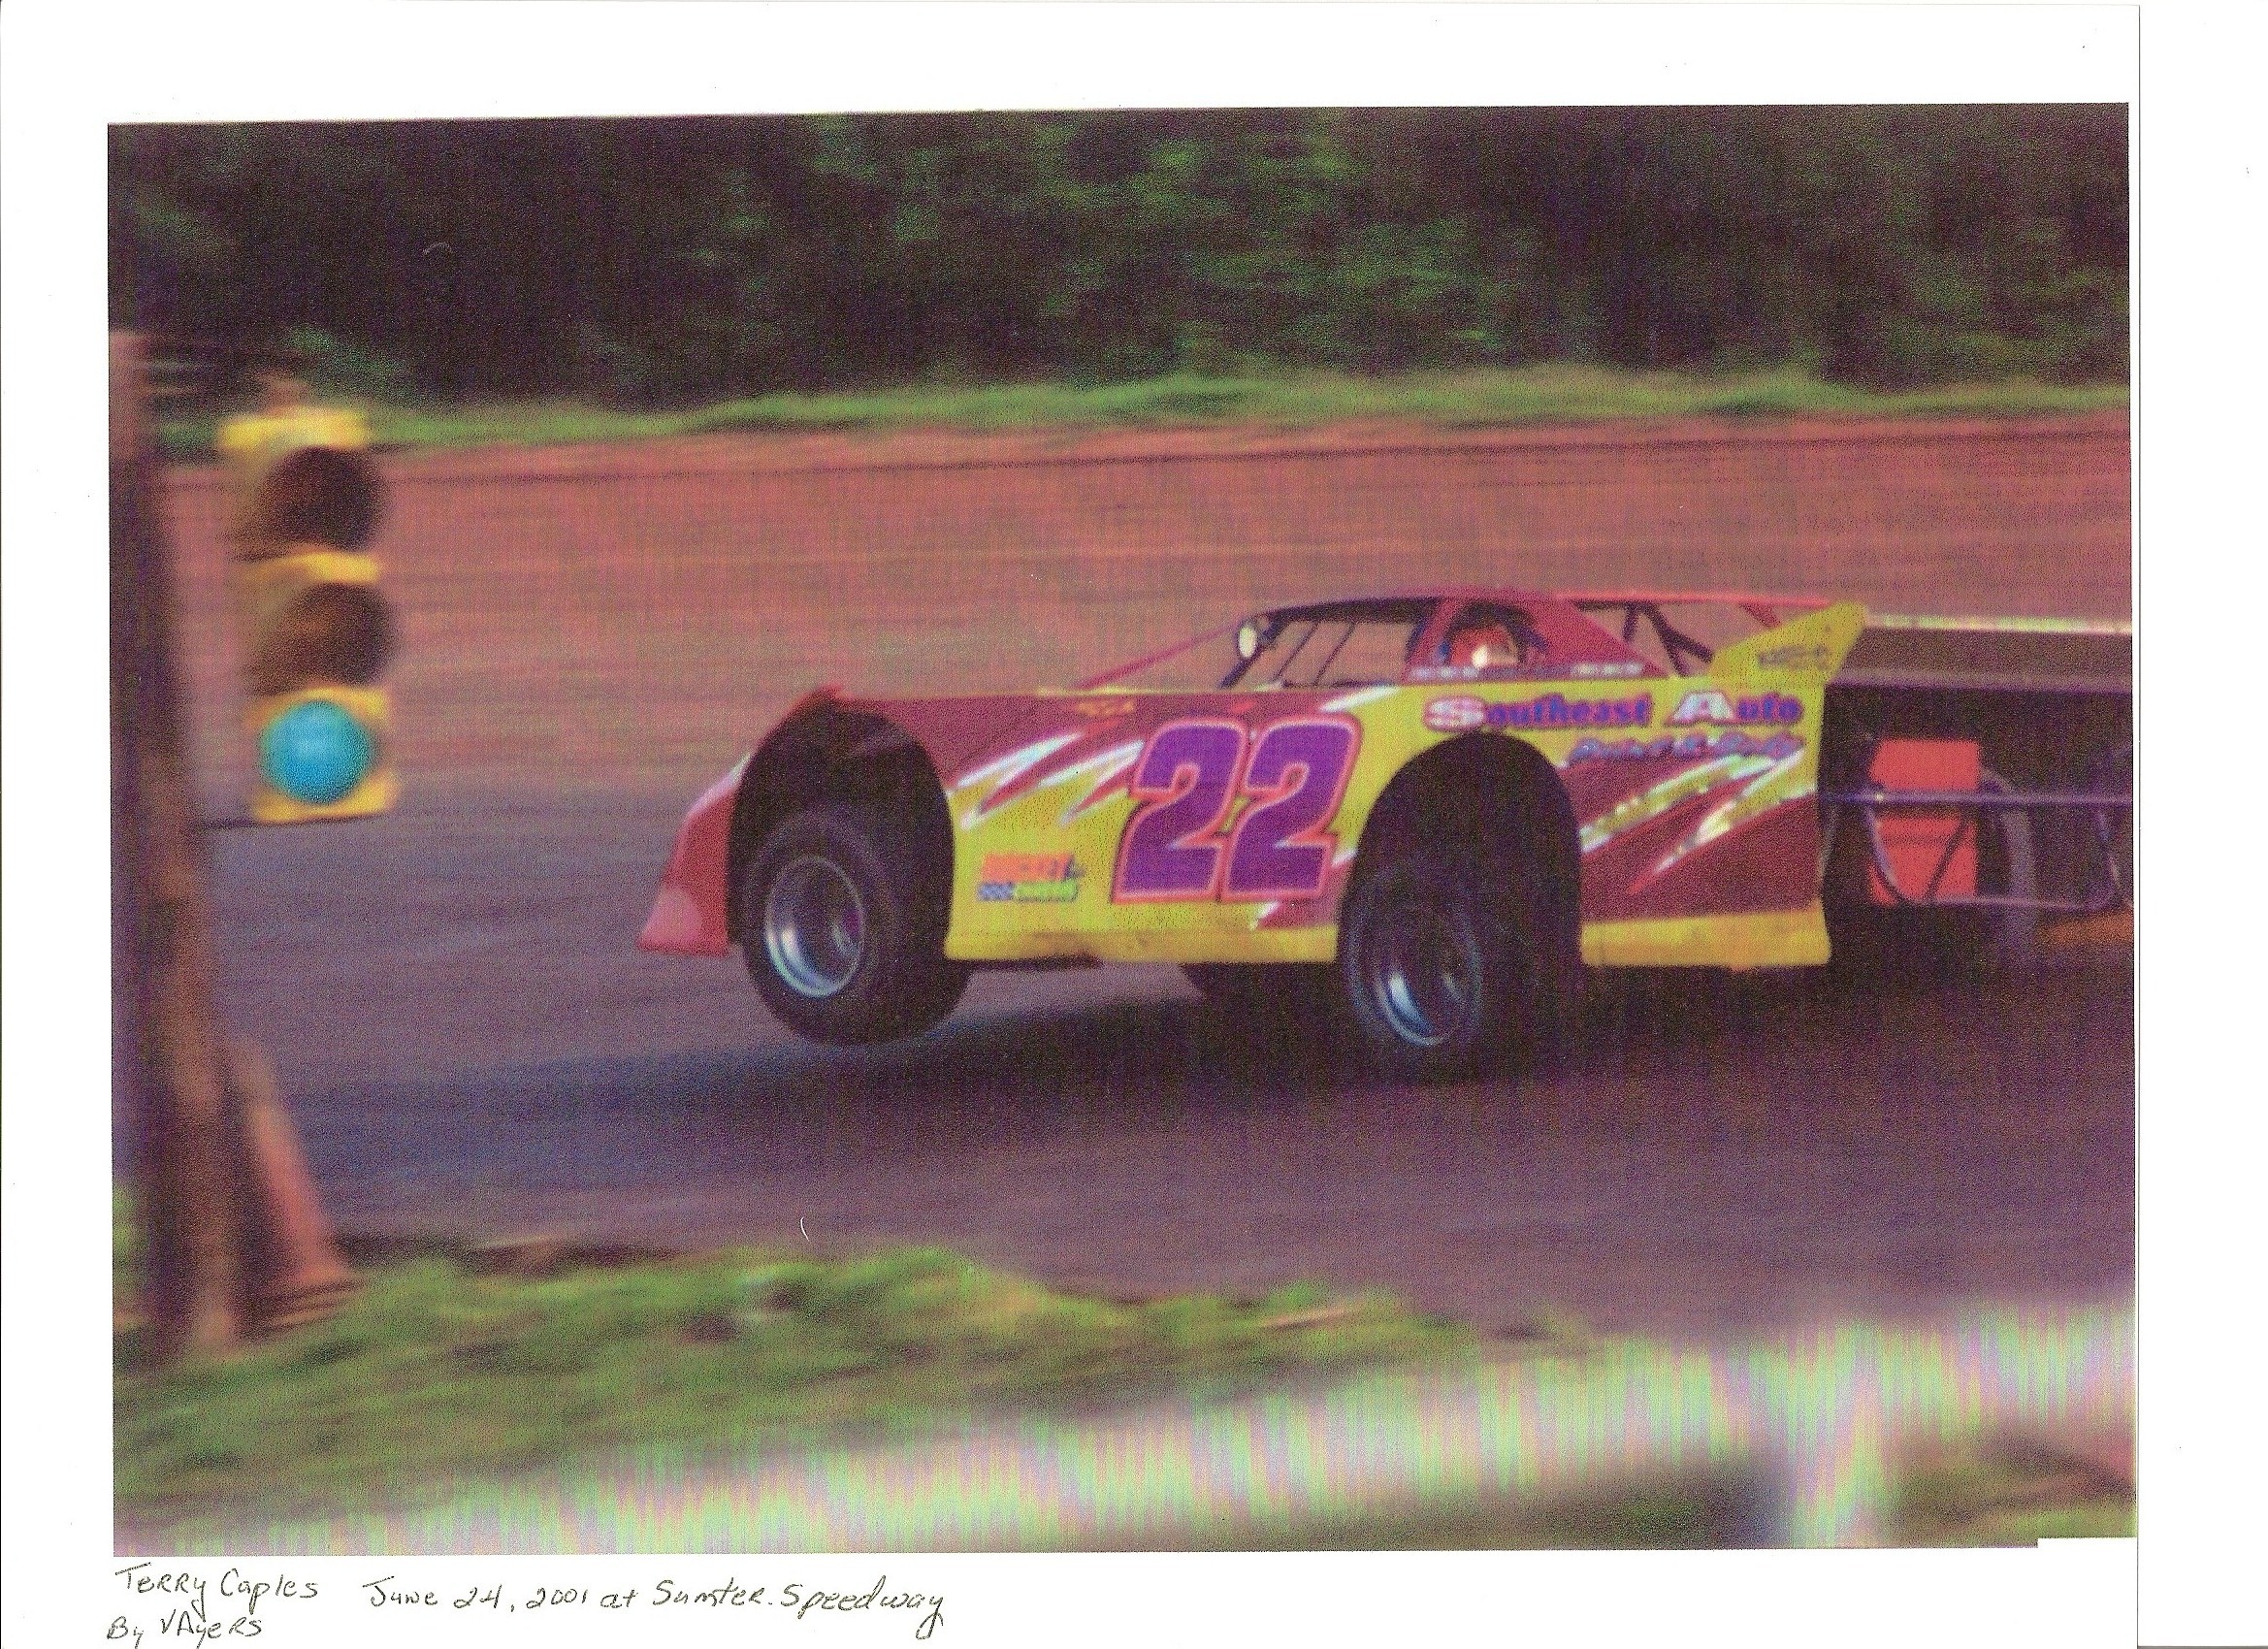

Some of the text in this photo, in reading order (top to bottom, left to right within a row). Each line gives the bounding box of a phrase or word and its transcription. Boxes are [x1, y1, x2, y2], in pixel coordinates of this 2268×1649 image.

[1423, 691, 1803, 732] Southeast Auto
[1111, 713, 1362, 903] 22
[220, 1568, 319, 1615] Caples
[362, 1575, 438, 1608] June
[526, 1587, 588, 1610] 2001
[599, 1588, 636, 1608] at
[780, 1574, 945, 1641] Speedway
[106, 1615, 144, 1649] By
